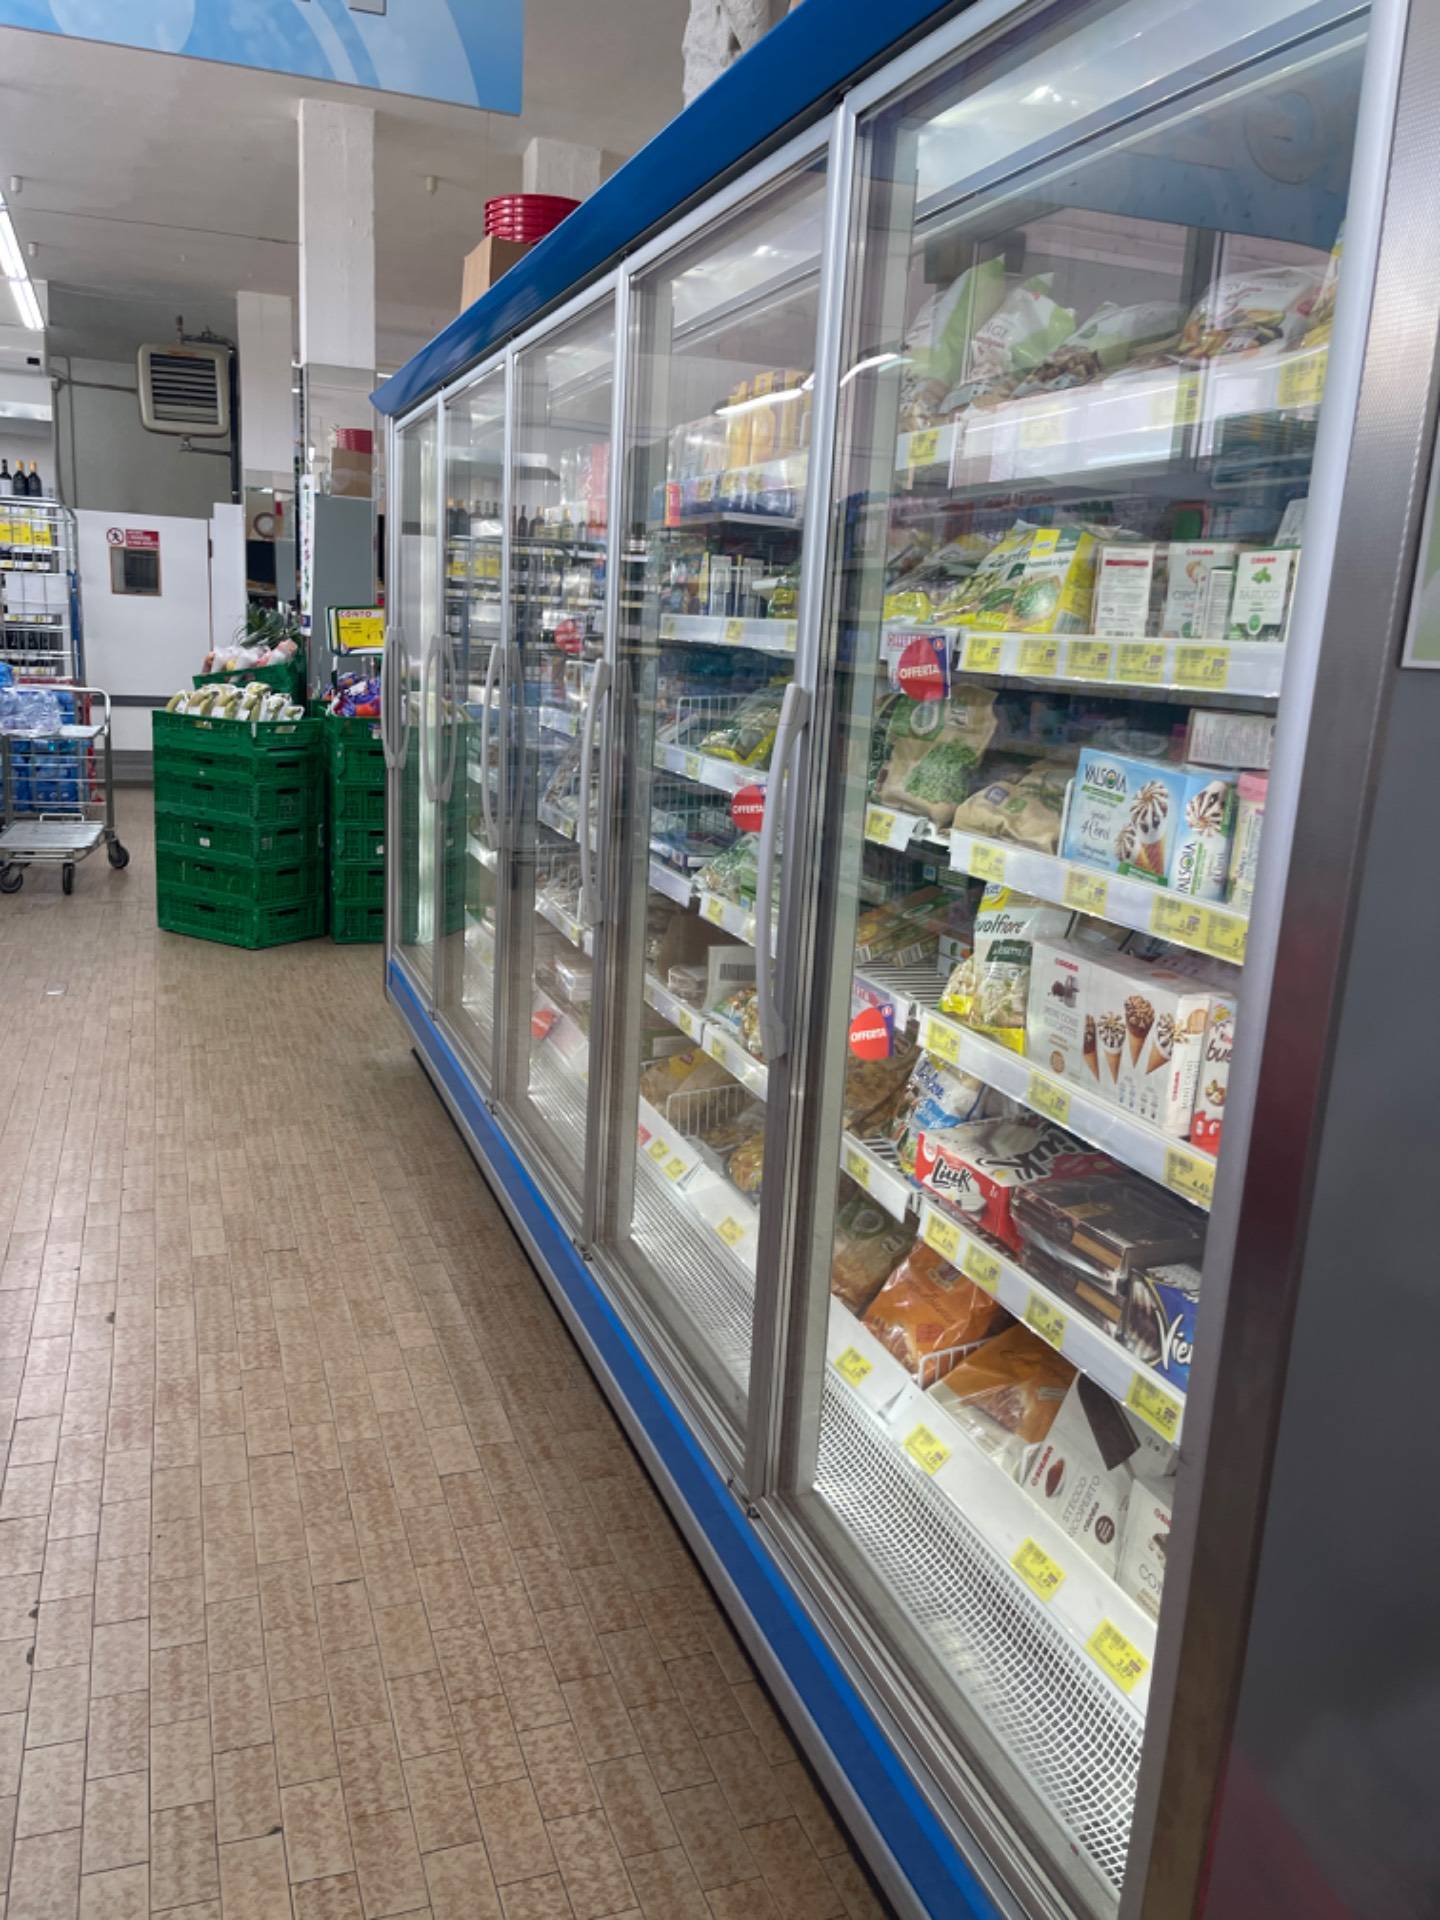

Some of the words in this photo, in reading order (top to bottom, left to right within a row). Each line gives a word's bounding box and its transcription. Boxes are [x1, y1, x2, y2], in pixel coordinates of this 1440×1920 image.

[899, 663, 940, 679] OFFERTA
[1084, 763, 1128, 793] VALSOIA
[850, 1028, 887, 1043] OFFERTA
